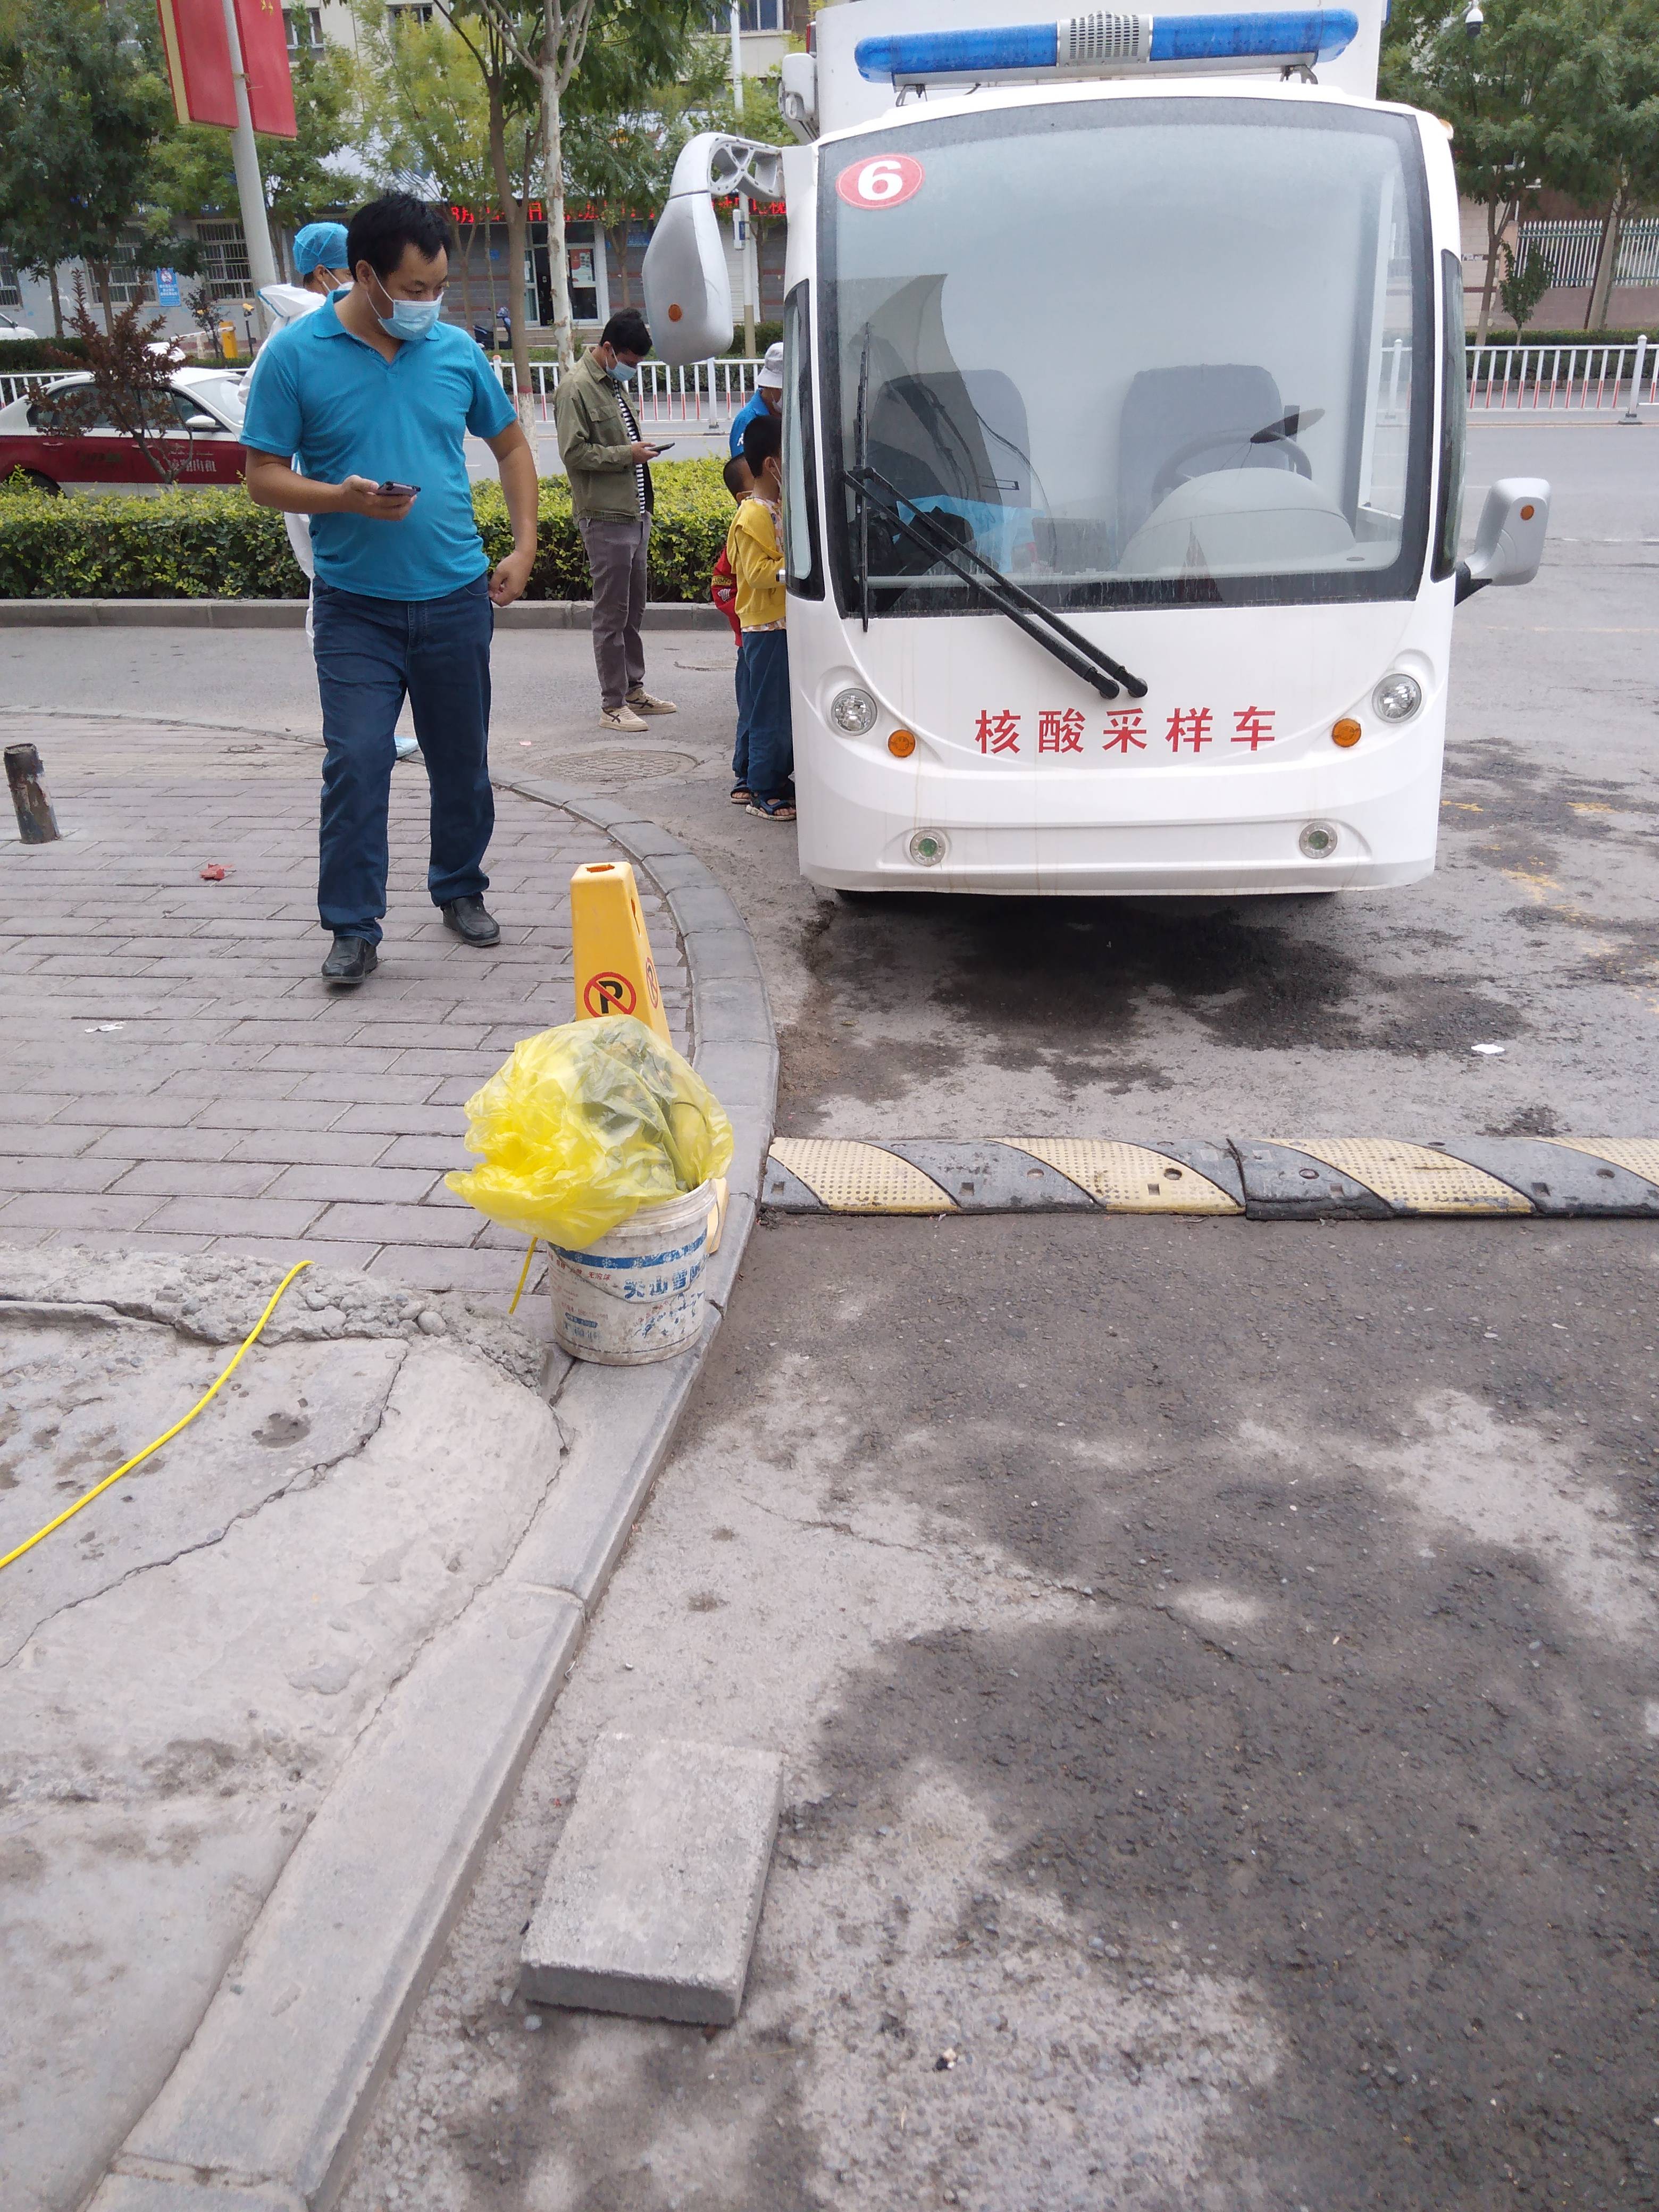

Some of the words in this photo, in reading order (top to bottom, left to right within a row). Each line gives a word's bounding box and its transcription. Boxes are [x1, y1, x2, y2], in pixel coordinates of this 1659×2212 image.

[858, 160, 903, 200] 6
[975, 705, 1276, 753] 核酸采样车
